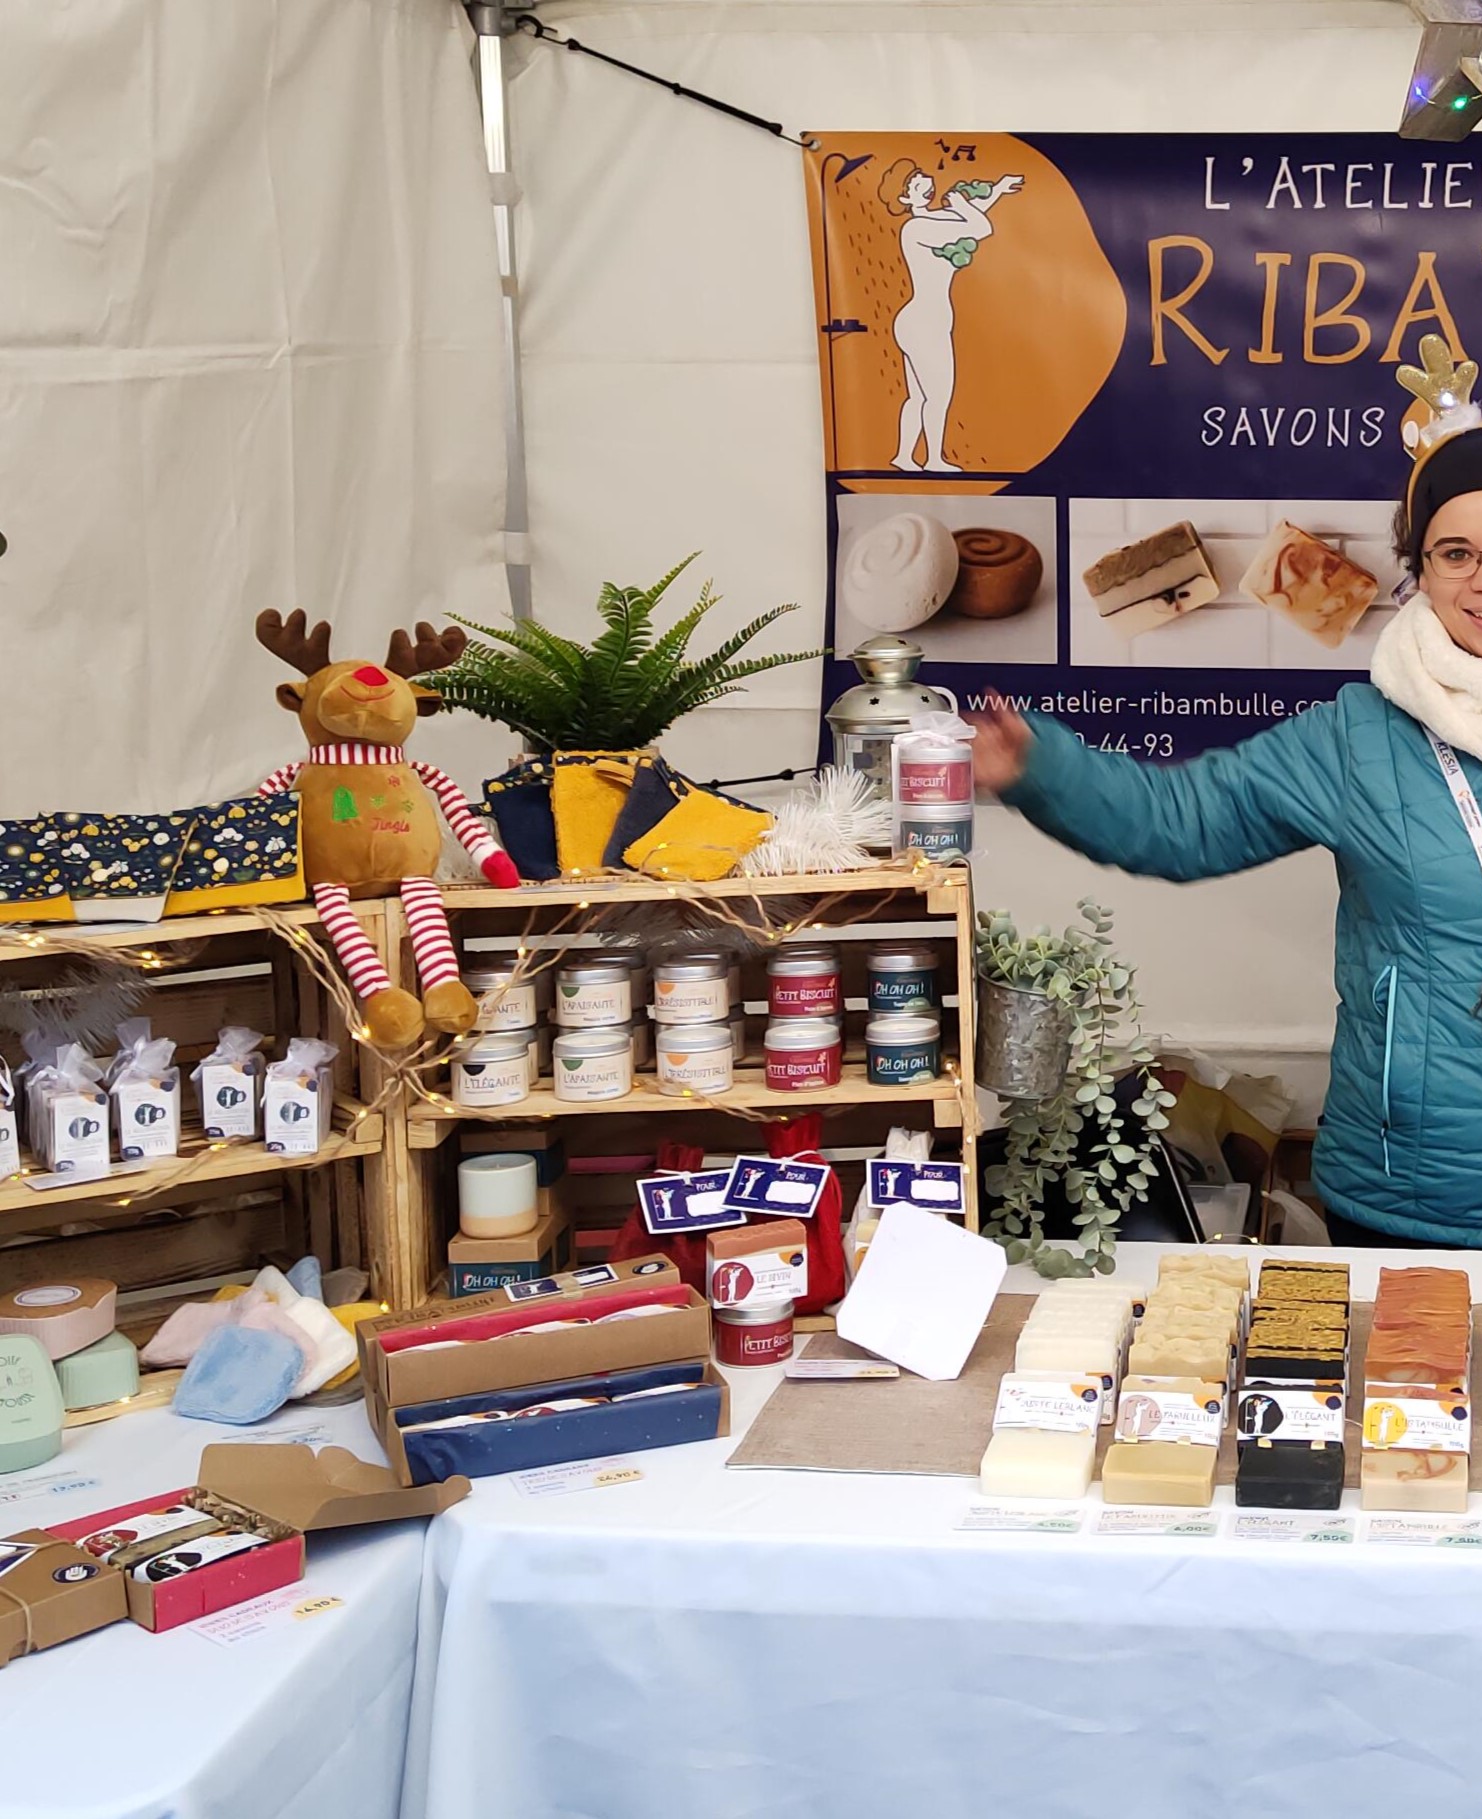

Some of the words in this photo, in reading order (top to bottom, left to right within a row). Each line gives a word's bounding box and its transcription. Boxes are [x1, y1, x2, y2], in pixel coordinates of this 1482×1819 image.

[1200, 405, 1386, 448] SAVONS
[800, 987, 835, 1000] BISCUIT
[787, 1062, 826, 1076] BISCUIT
